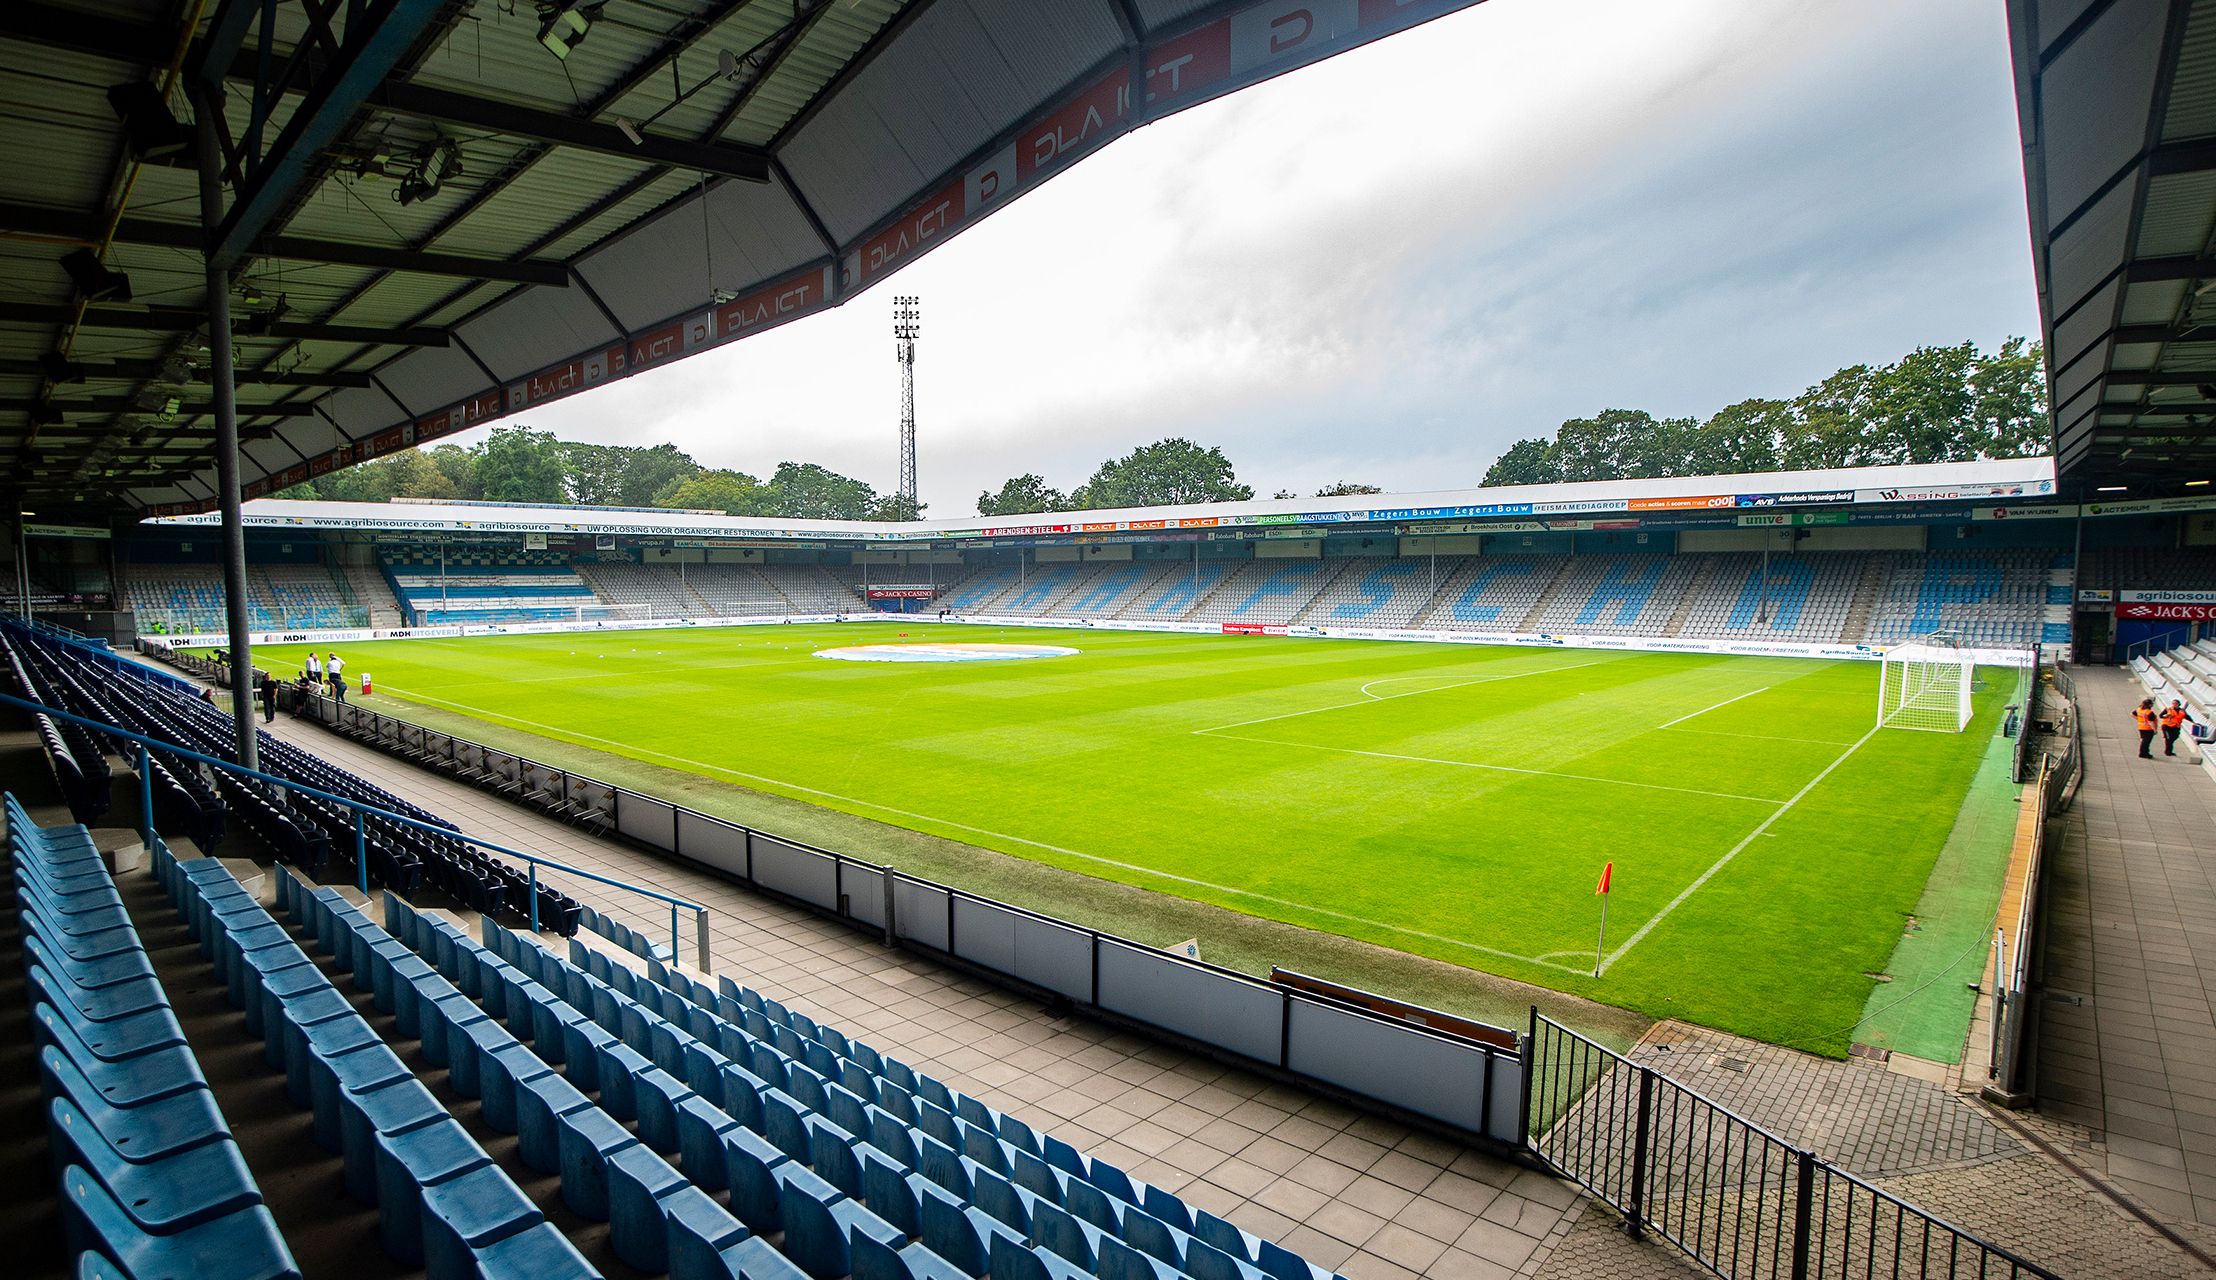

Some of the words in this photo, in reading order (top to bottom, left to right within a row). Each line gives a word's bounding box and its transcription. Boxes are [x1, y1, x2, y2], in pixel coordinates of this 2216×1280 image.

[1034, 104, 1103, 168] DLA
[870, 229, 910, 271] DLA
[915, 200, 950, 240] ICT
[727, 303, 768, 332] DLA
[775, 284, 810, 314] ICT
[615, 347, 645, 371] DA
[649, 335, 674, 359] ICT
[1708, 495, 1735, 507] coop
[1373, 510, 1408, 519] Zegers
[1412, 508, 1441, 516] Bouw
[1454, 506, 1492, 516] Zegers
[1497, 504, 1529, 513] Bouw
[187, 515, 277, 525] agribource
[313, 518, 444, 530] www.agribiosource.com
[479, 522, 550, 532] agribiosource
[602, 525, 649, 534] OPLOSSING
[674, 527, 722, 536] ORGANISCHE
[723, 529, 774, 537] RESTSTROMEN
[2136, 591, 2216, 601] agribiosou
[2154, 605, 2206, 618] JACK'S
